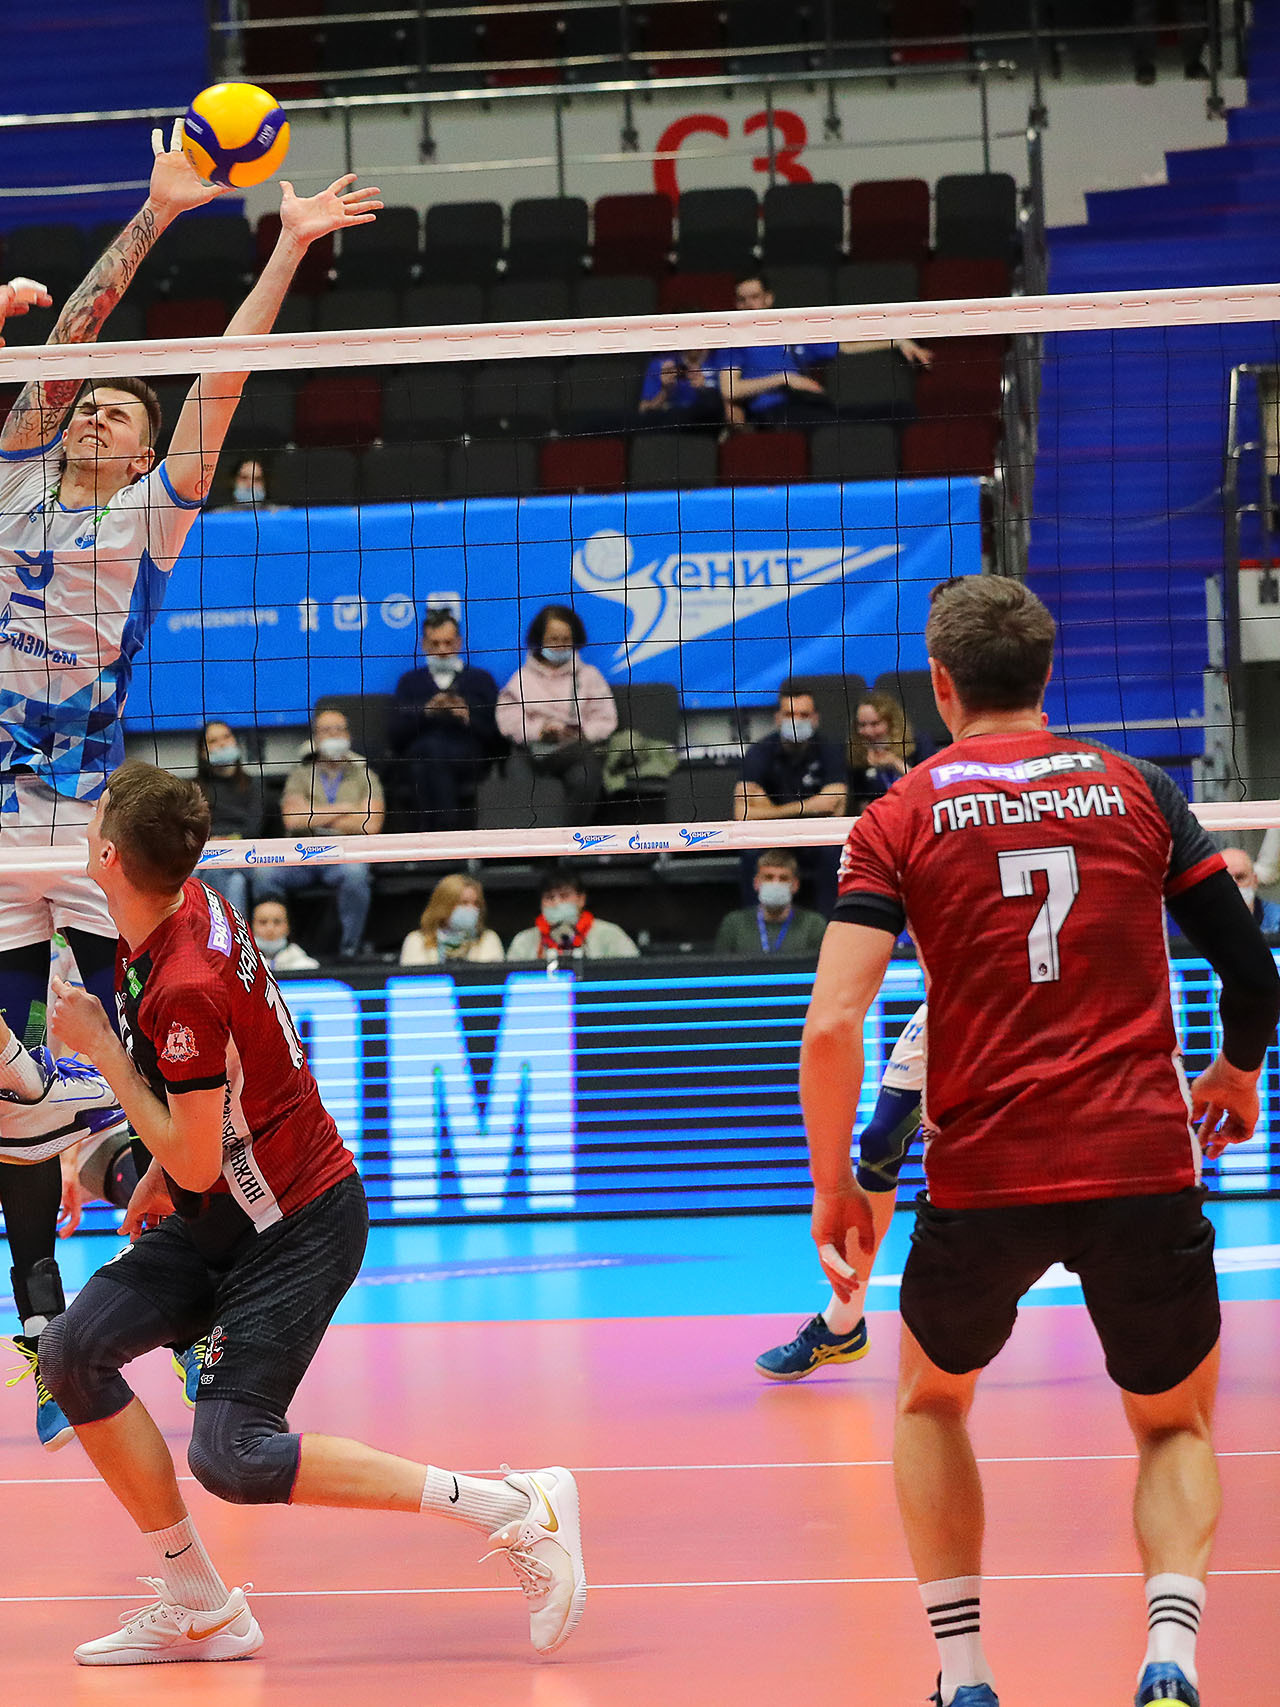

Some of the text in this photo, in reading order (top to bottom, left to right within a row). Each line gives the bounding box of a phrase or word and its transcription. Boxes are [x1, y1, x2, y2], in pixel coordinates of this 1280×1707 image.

[938, 753, 1097, 782] PARIBET
[932, 784, 1127, 834] ПЯТЫРКИН
[256, 855, 285, 863] ГАЗПРОМ
[997, 845, 1081, 983] 7
